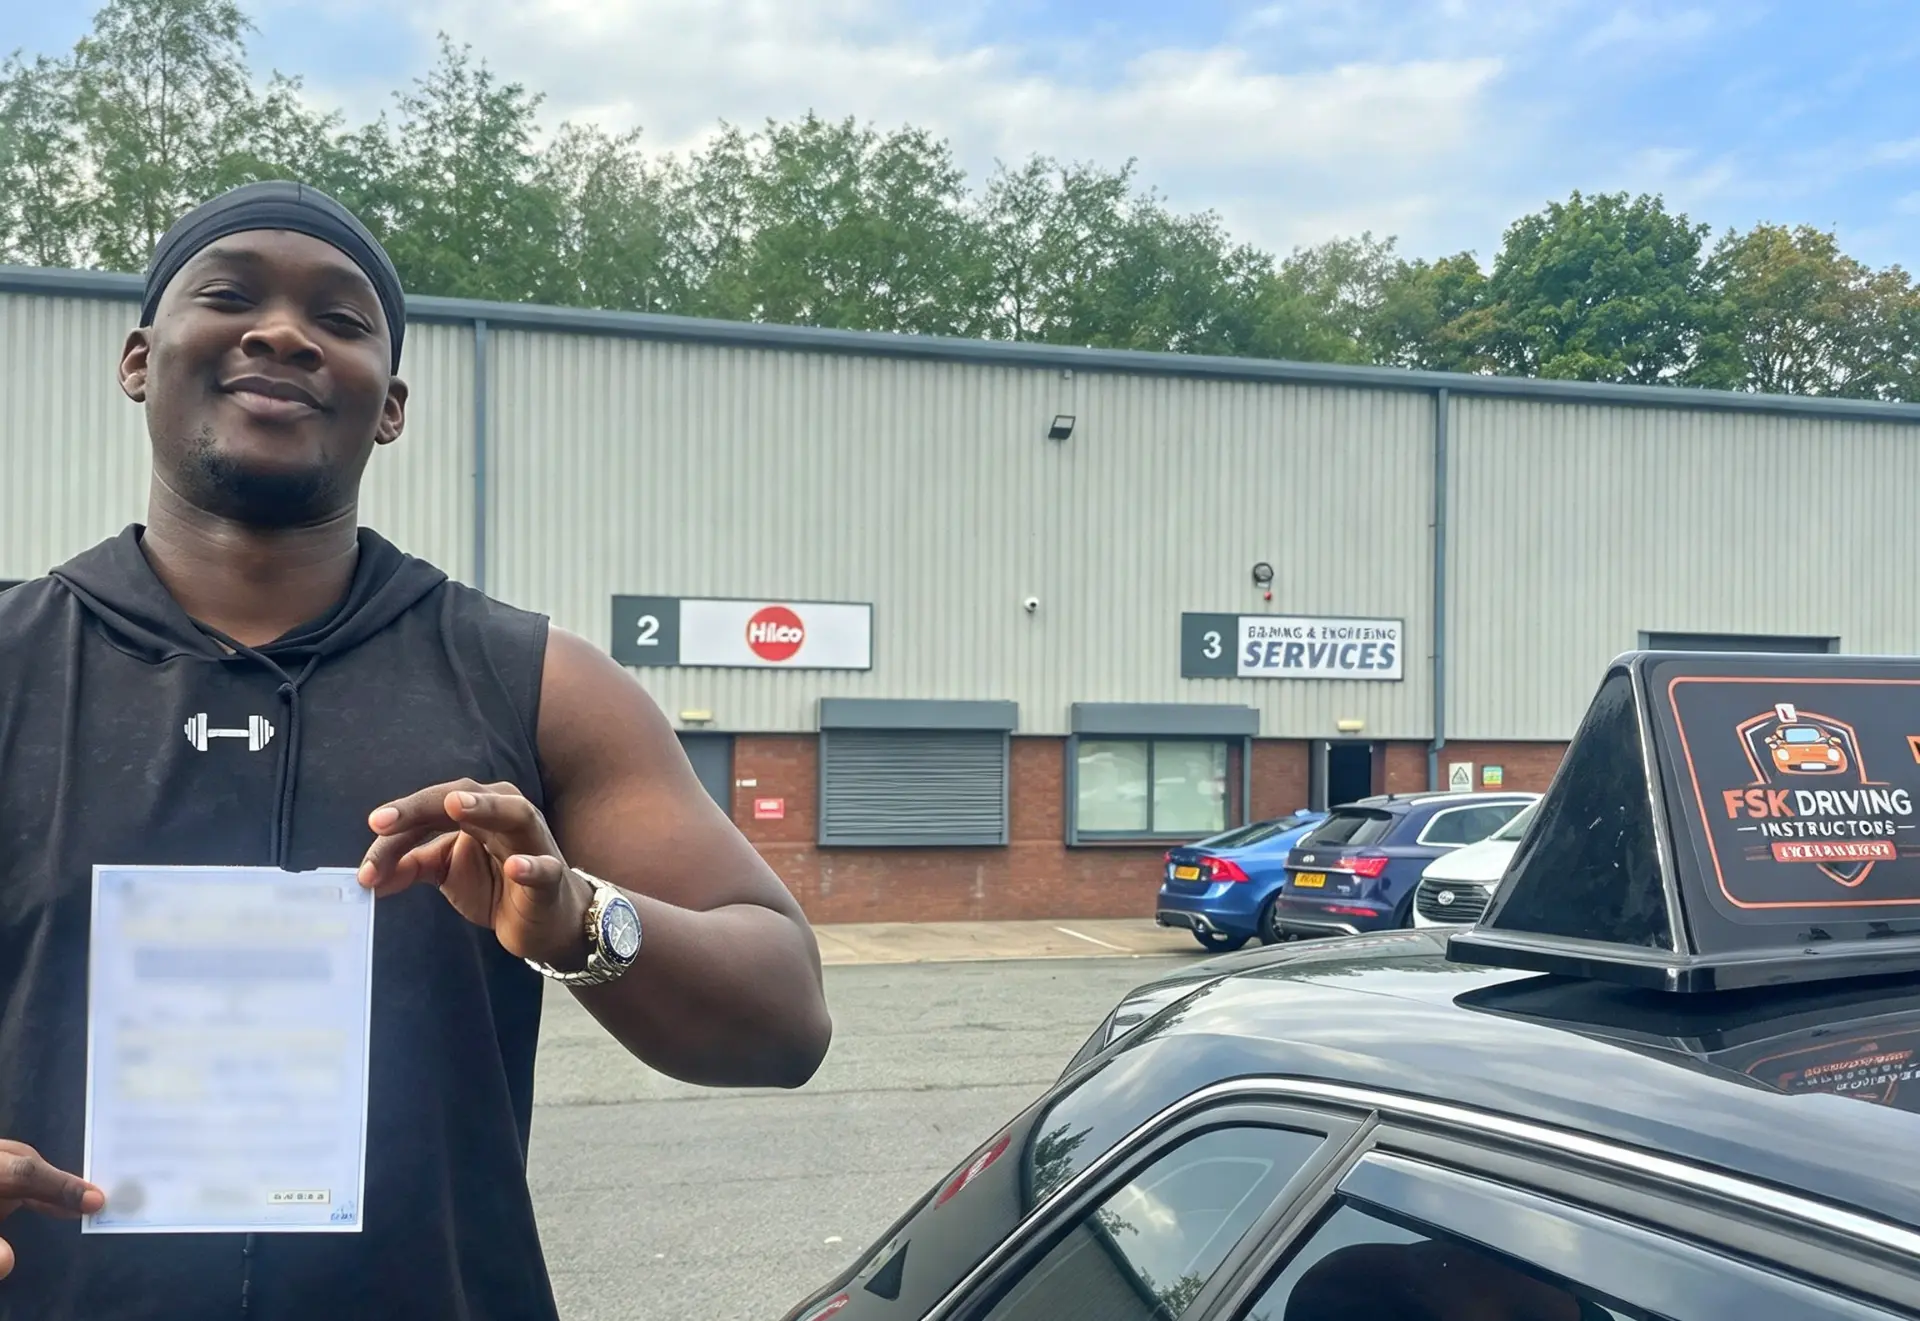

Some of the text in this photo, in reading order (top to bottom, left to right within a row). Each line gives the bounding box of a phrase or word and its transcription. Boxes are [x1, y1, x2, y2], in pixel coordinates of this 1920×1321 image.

[637, 614, 660, 646] 2
[749, 621, 803, 645] Hilco
[1202, 631, 1223, 660] 3
[1243, 641, 1396, 670] SERVICES
[1722, 789, 1913, 819] FSK DRIVING
